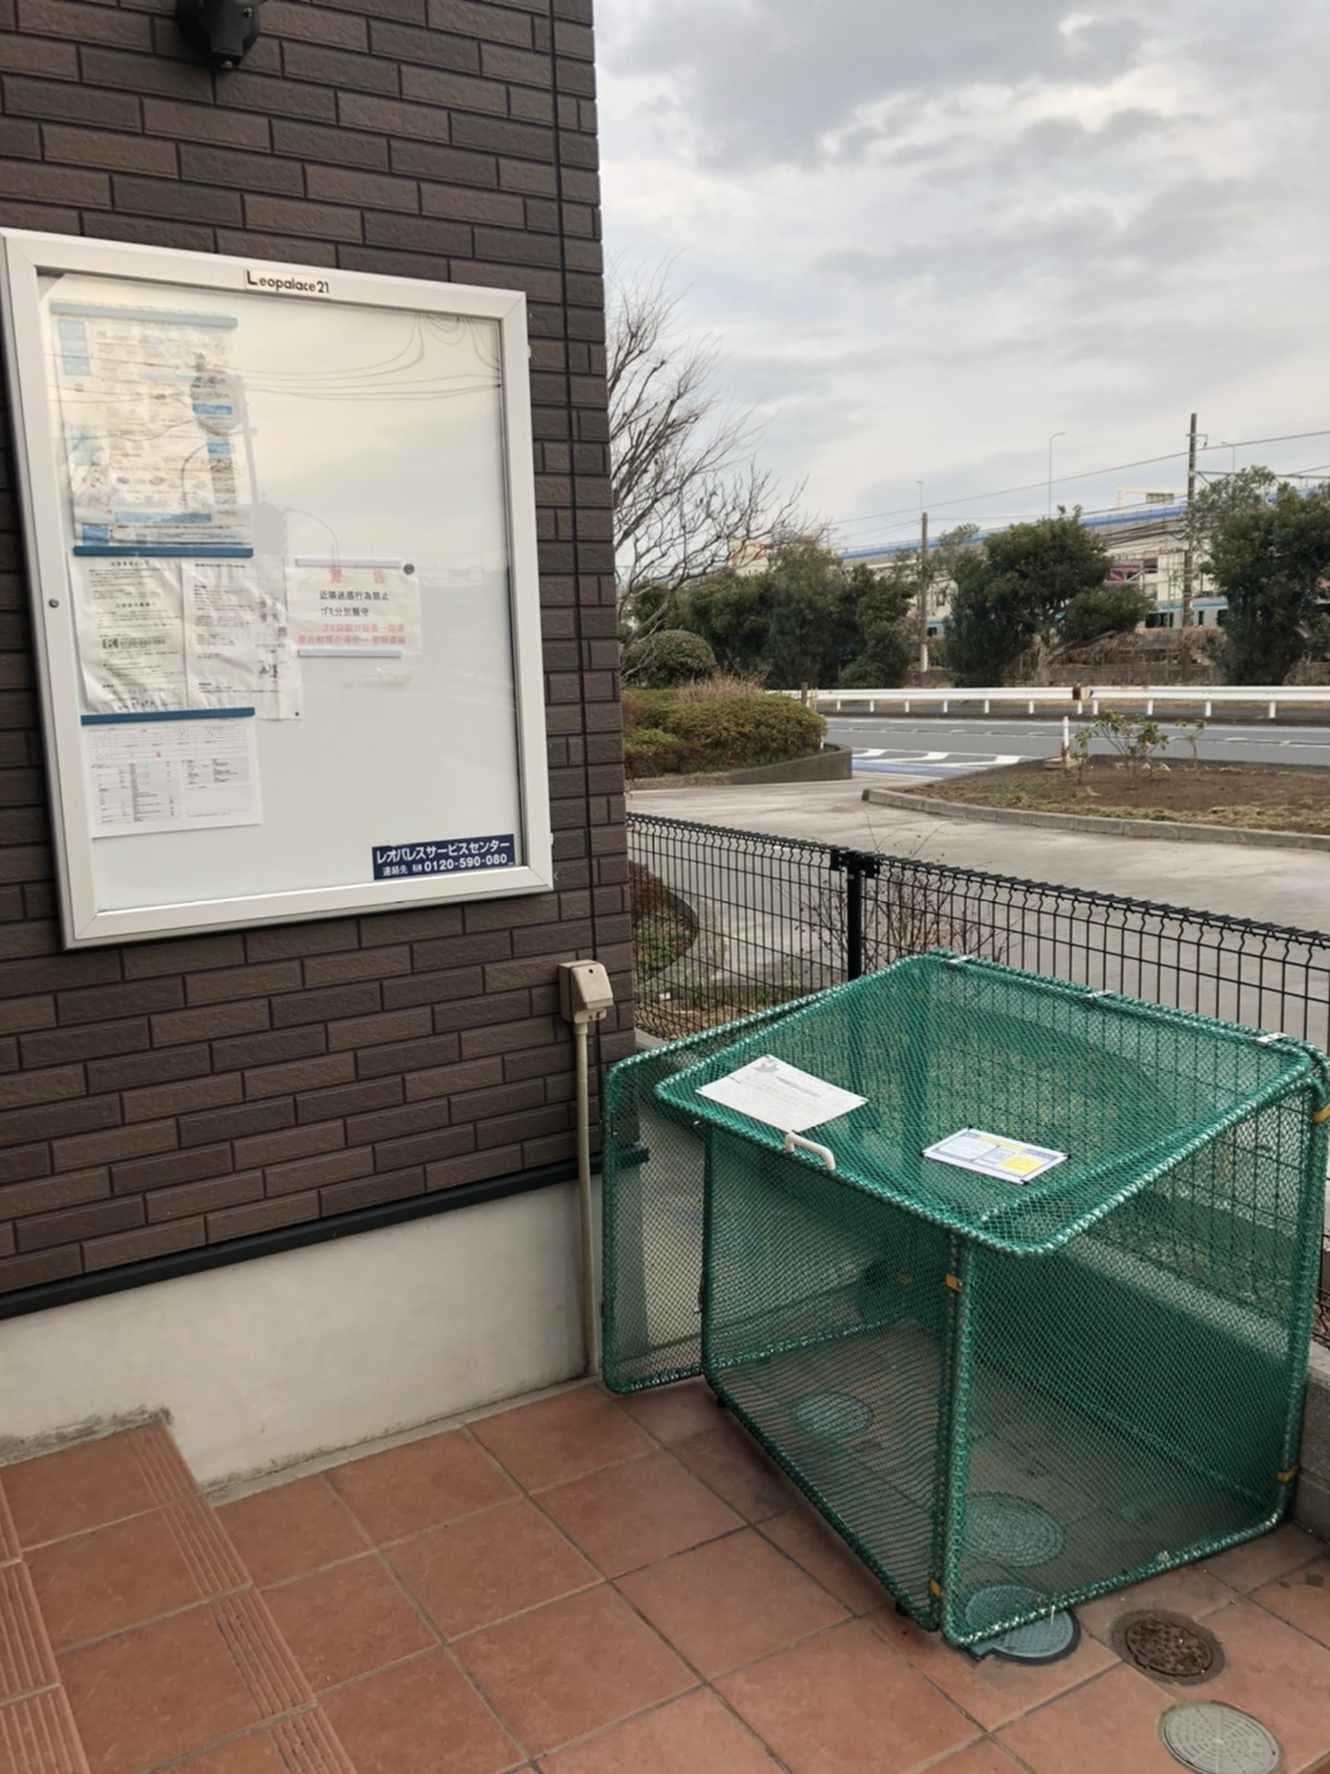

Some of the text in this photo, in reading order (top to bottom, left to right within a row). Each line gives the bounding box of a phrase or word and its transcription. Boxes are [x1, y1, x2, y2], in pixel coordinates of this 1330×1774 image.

[247, 270, 329, 293] Leopalace21
[377, 839, 510, 863] レオパレスサービスセンター
